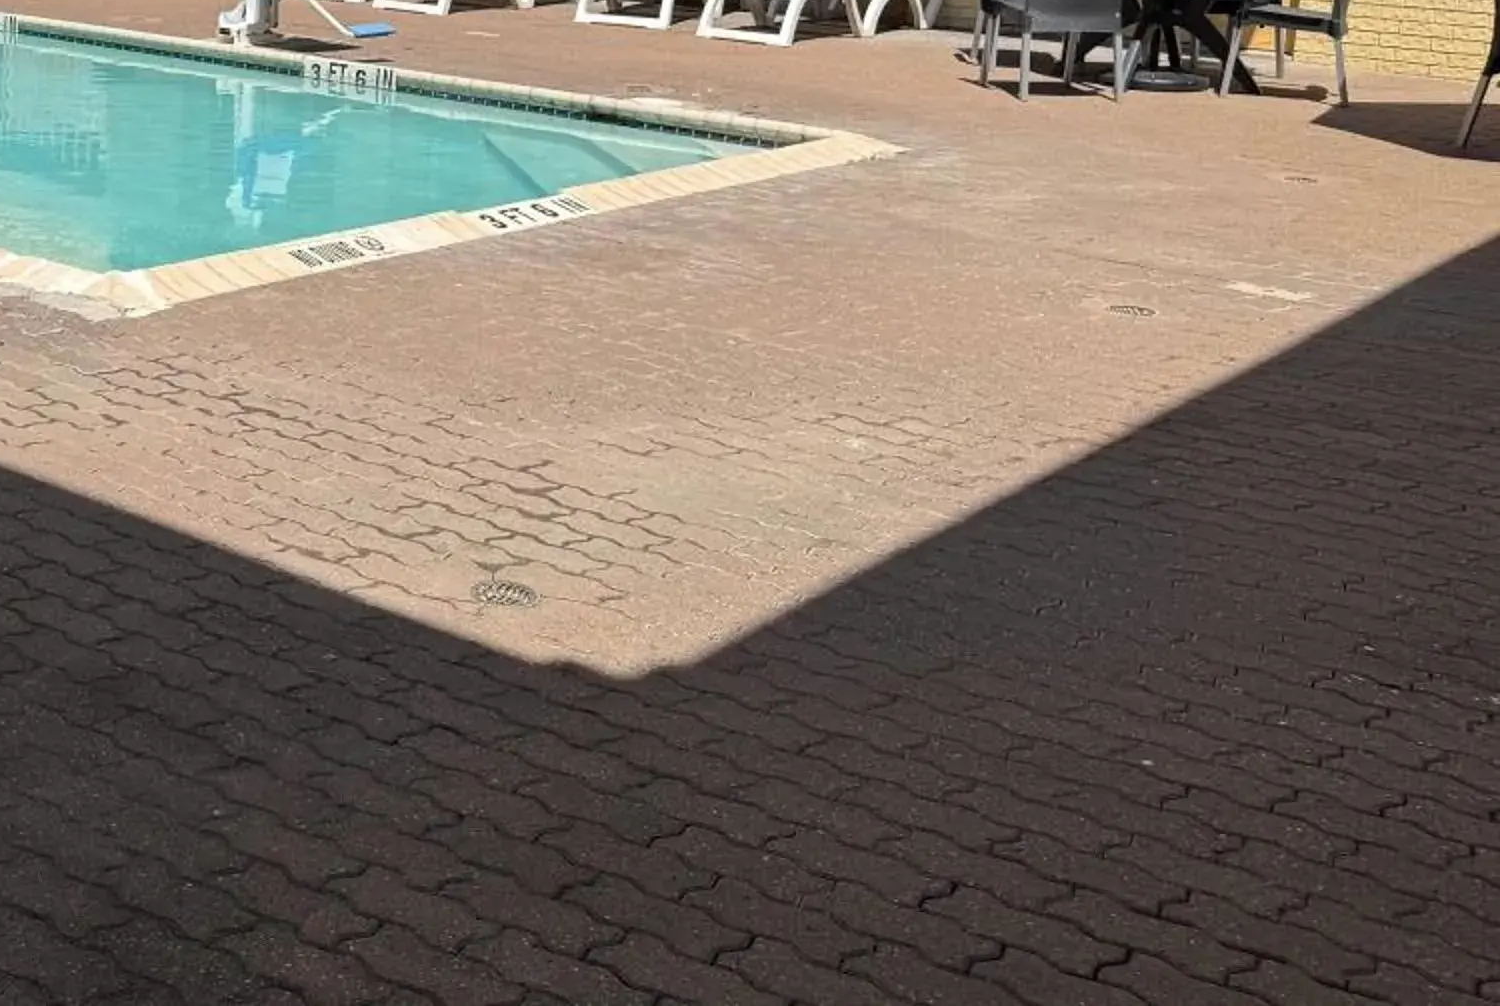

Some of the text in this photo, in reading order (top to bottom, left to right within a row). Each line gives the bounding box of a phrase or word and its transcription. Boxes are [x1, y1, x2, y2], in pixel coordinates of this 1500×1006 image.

[3, 15, 18, 32] IN
[311, 61, 394, 90] 3 FT 6 IN
[479, 196, 592, 229] 3 FT 6 IN
